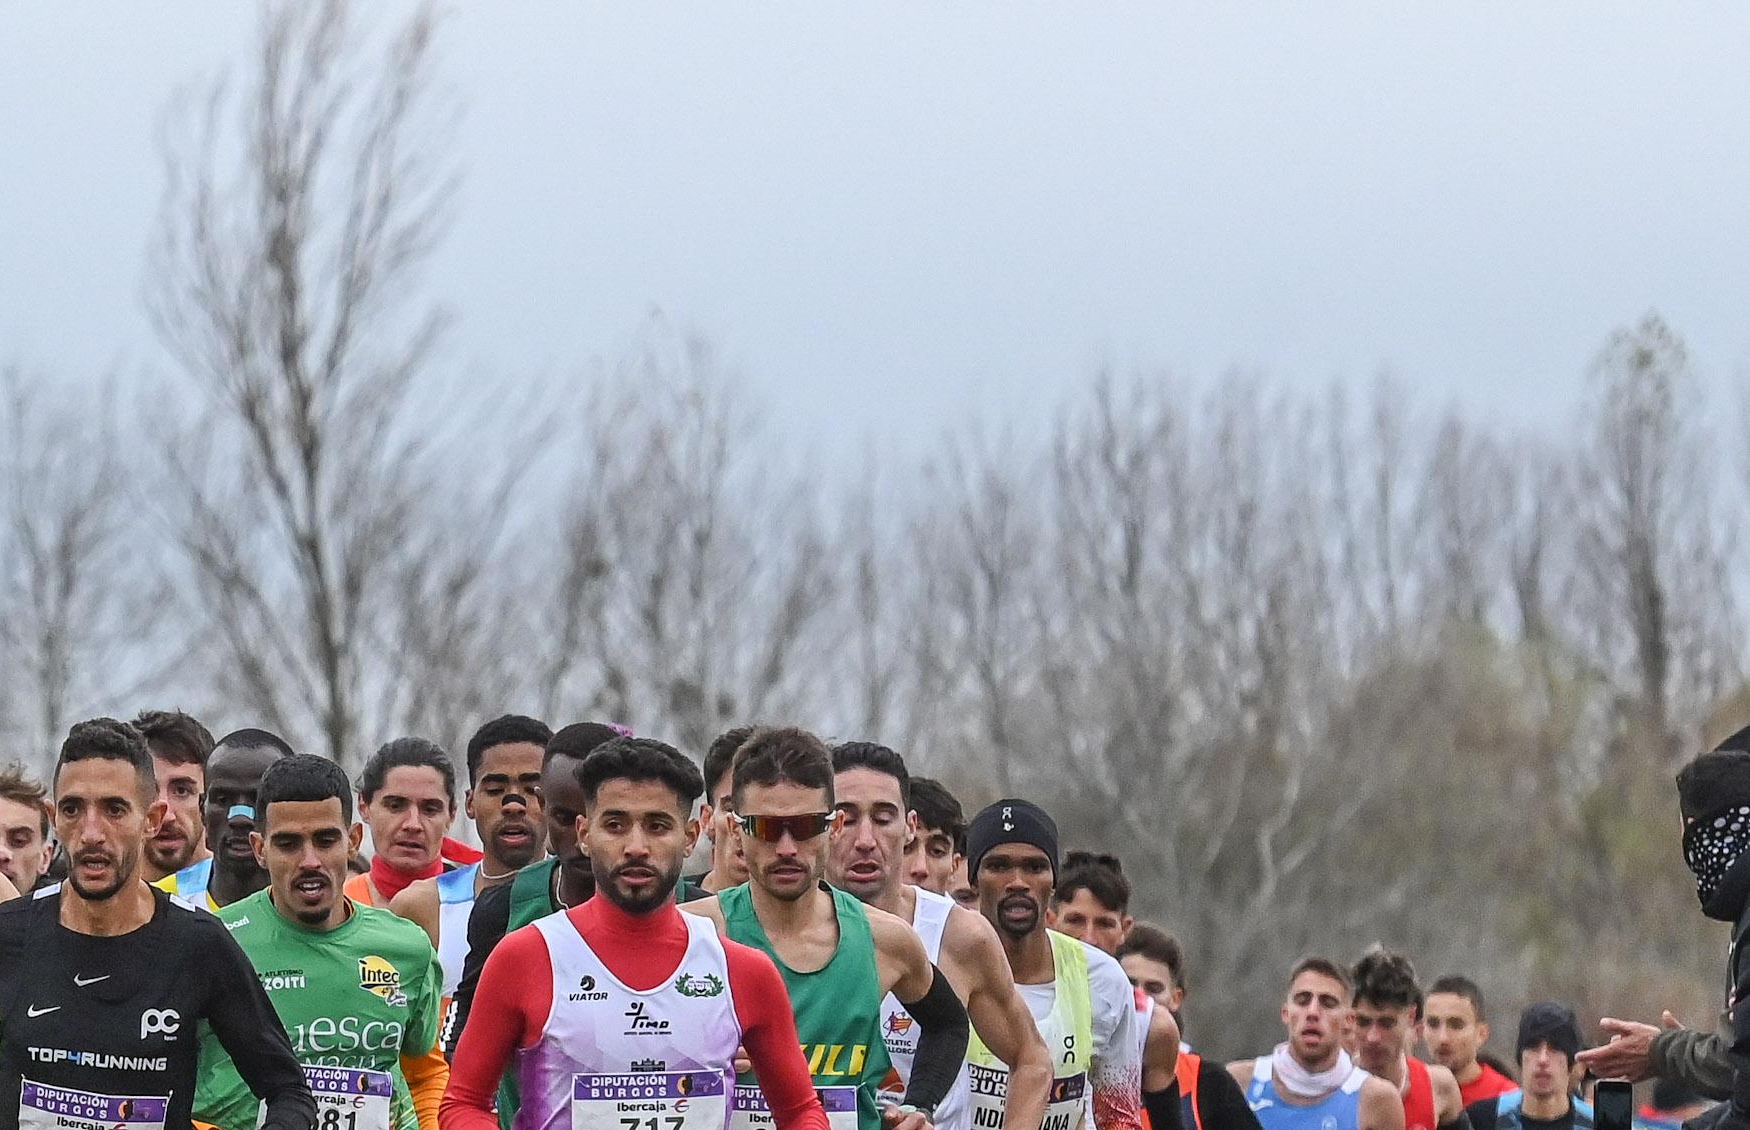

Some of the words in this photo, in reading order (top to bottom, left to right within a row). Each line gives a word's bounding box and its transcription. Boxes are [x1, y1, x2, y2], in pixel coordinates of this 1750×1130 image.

[569, 992, 608, 1002] VIATOR
[27, 1046, 168, 1072] TOP4RUNNING
[591, 1074, 667, 1087] DIPUTACIÓN
[36, 1087, 109, 1109] DIPUTACIÓN
[591, 1086, 667, 1098] BURGOS
[35, 1099, 108, 1119] BURGOS
[616, 1101, 667, 1114] Ibercaja
